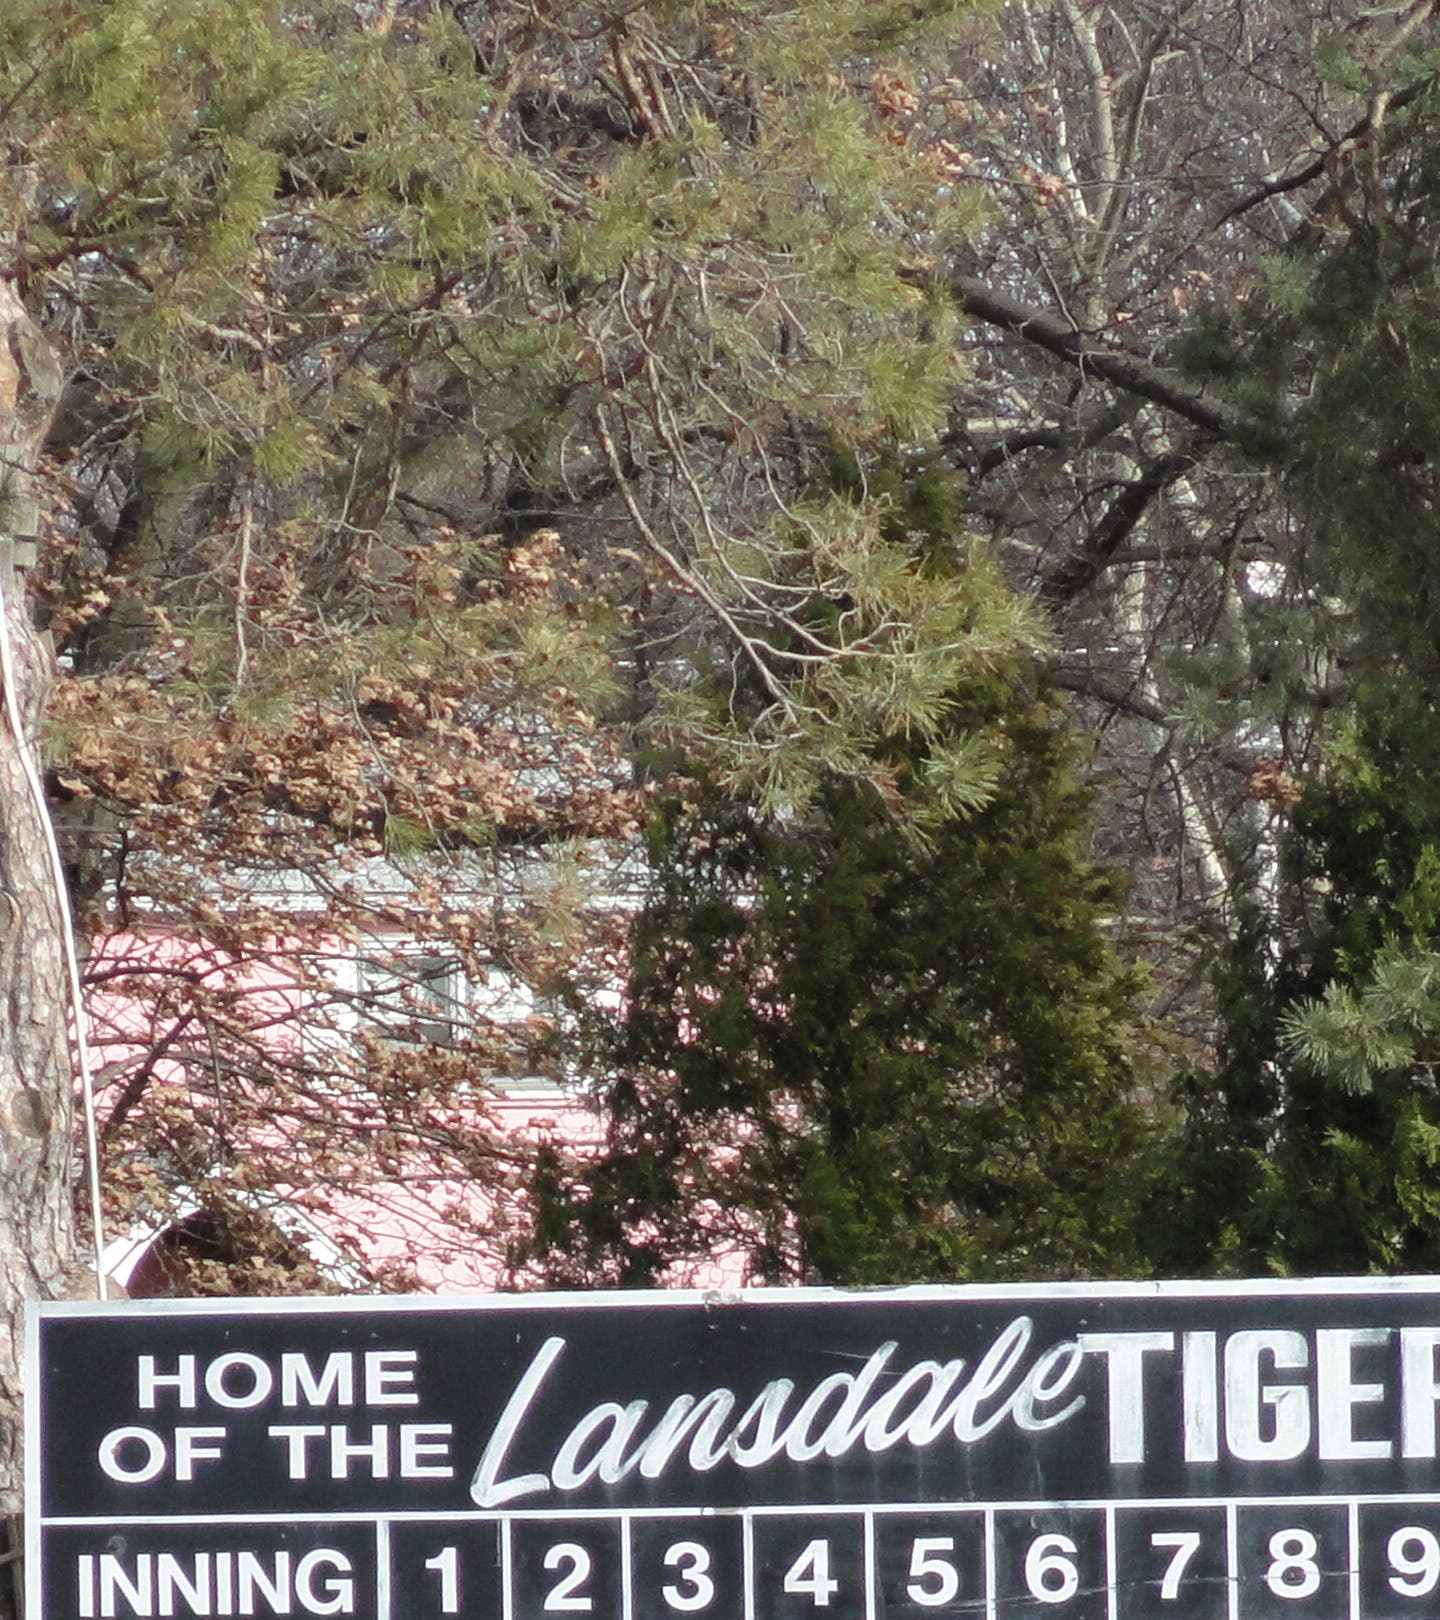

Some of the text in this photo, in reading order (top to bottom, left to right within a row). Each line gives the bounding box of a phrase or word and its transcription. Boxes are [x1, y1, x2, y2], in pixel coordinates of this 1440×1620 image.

[138, 1350, 420, 1409] HOME
[471, 1315, 1086, 1508] Lansdale
[98, 1423, 454, 1484] OF THE
[78, 1548, 354, 1618] INNING
[425, 1546, 458, 1613] 1
[543, 1542, 593, 1611] 2
[662, 1541, 715, 1612] 3
[783, 1539, 839, 1606] 4
[906, 1537, 959, 1606] 5
[1025, 1534, 1079, 1603] 6
[1151, 1532, 1201, 1600] 7
[1267, 1529, 1321, 1599] 8
